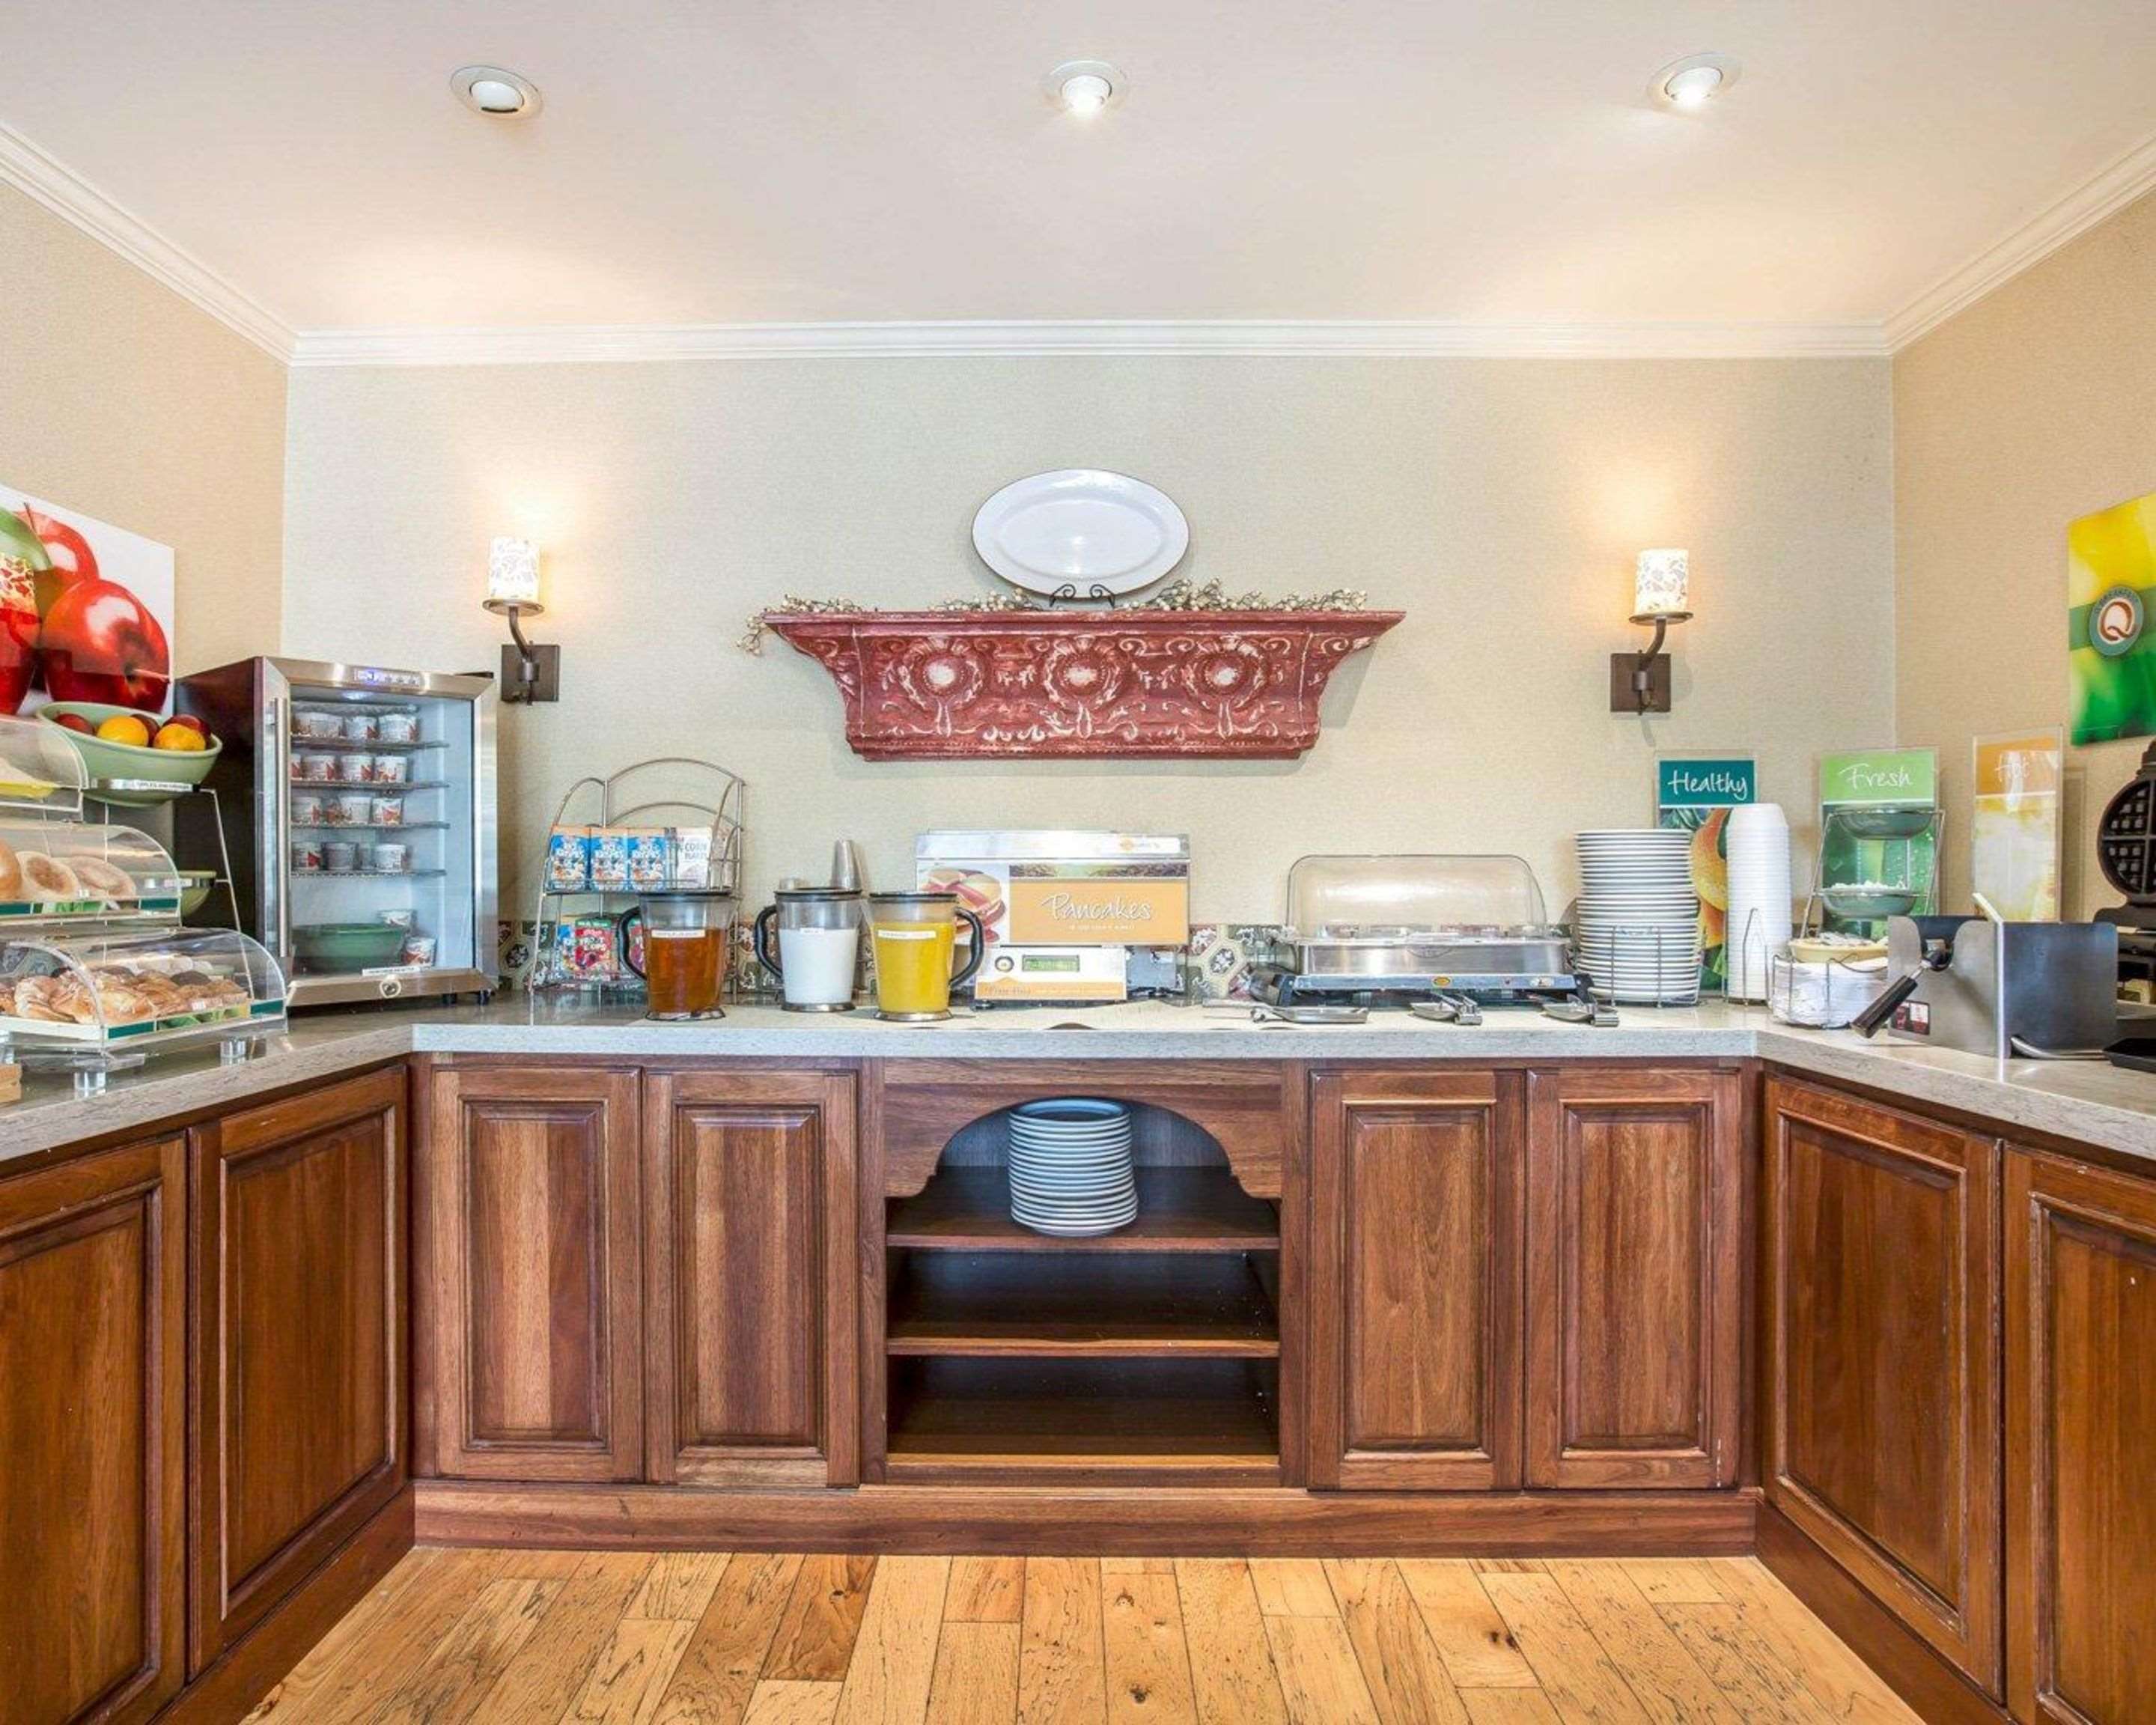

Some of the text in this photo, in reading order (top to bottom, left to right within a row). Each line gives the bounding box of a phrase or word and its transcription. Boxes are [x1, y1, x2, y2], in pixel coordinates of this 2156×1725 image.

[2100, 600, 2137, 641] Q
[1667, 770, 1747, 800] Healthy
[1838, 762, 1913, 790] Fresh
[1041, 892, 1151, 921] Pancakes
